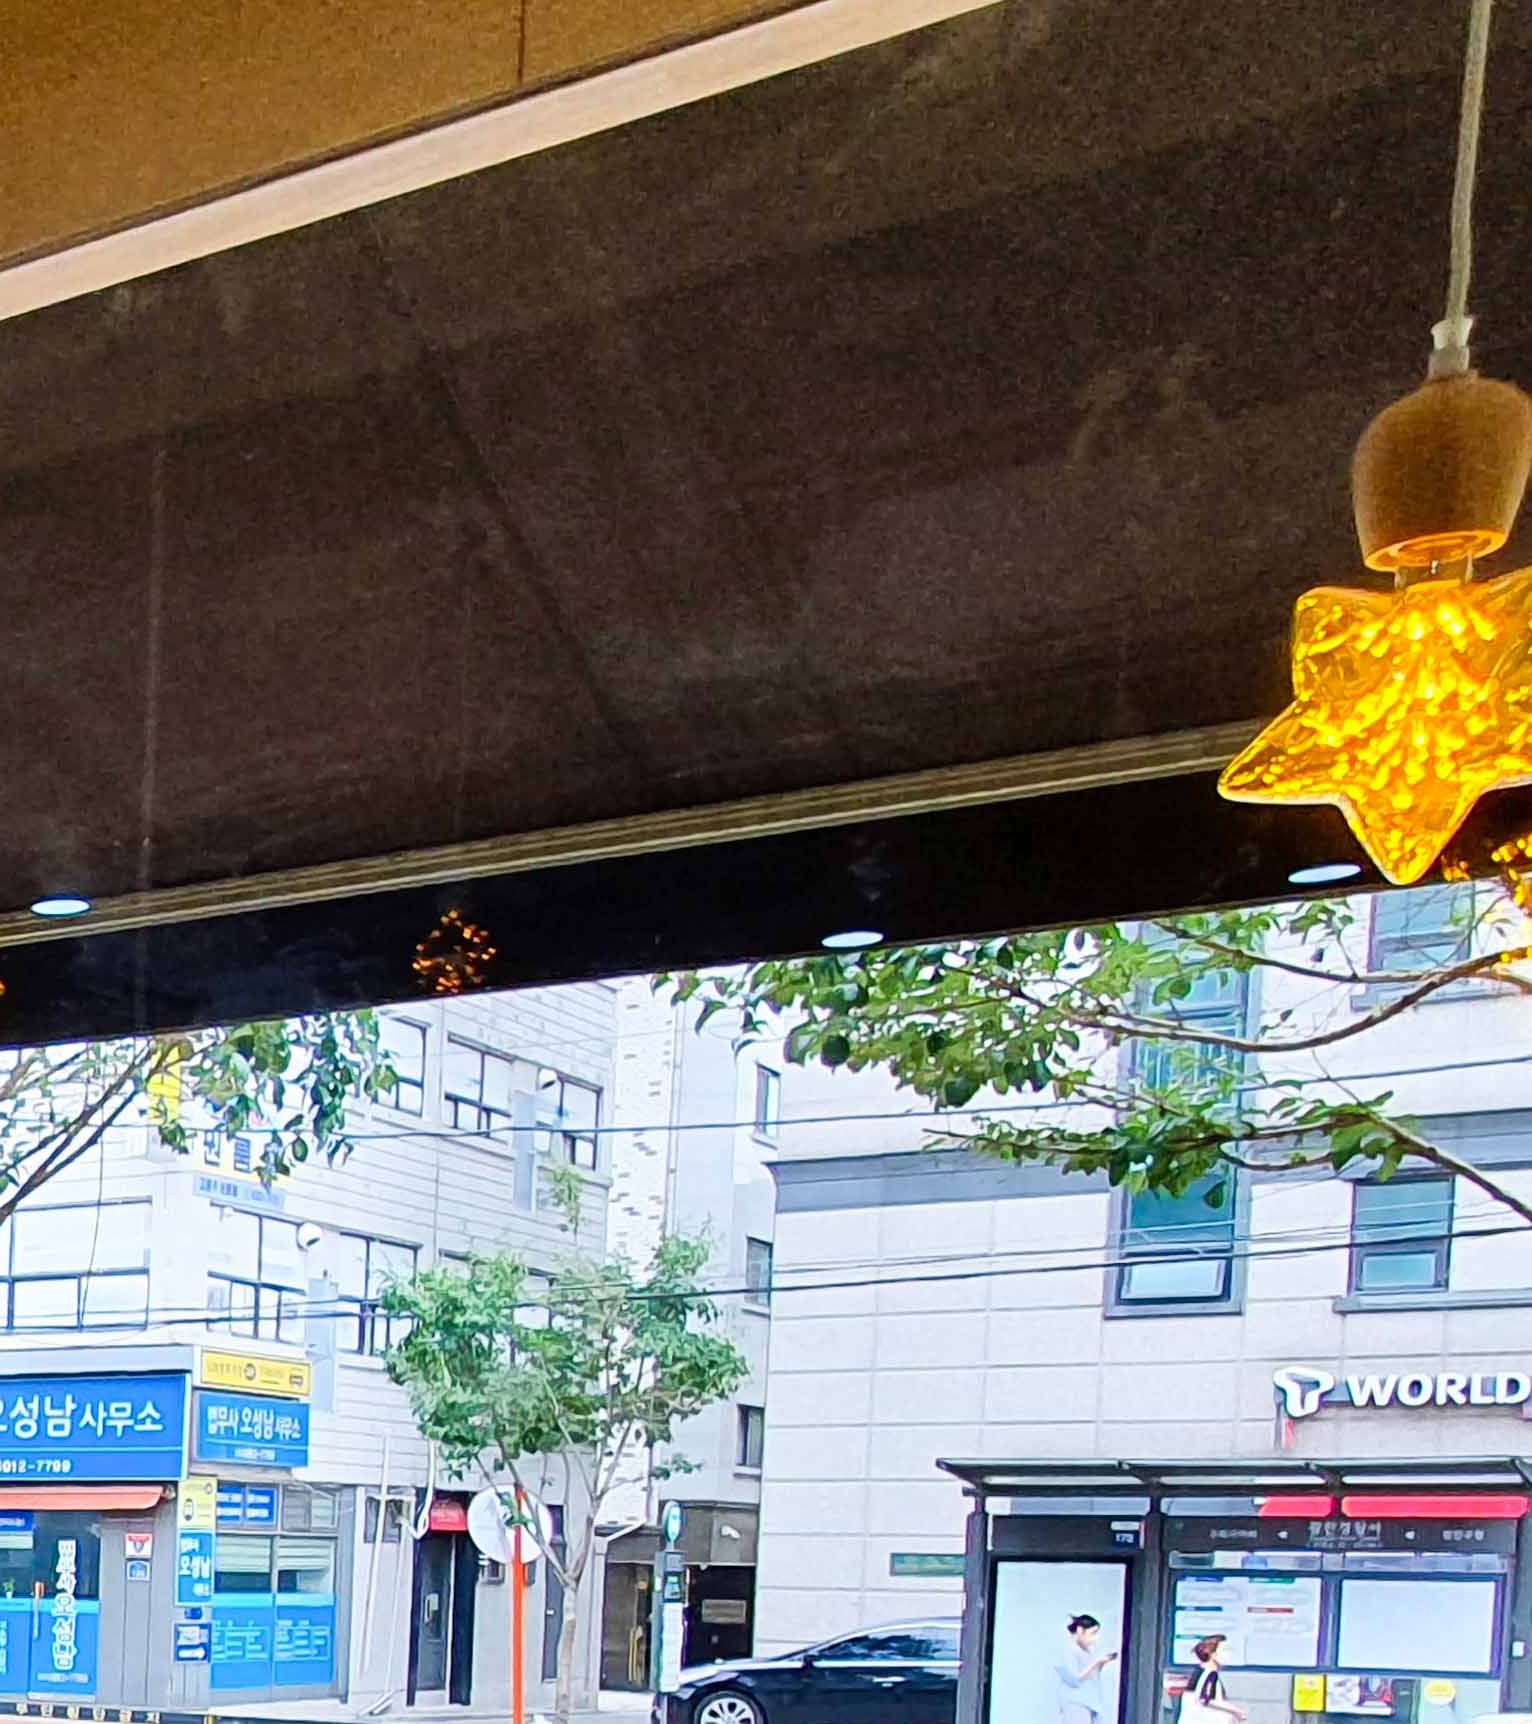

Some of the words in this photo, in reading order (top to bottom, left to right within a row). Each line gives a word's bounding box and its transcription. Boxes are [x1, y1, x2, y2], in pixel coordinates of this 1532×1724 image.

[1345, 1372, 1531, 1407] WORLD
[78, 1400, 164, 1438] 사무소
[207, 1405, 238, 1437] 법무사
[240, 1407, 274, 1440] 오성남
